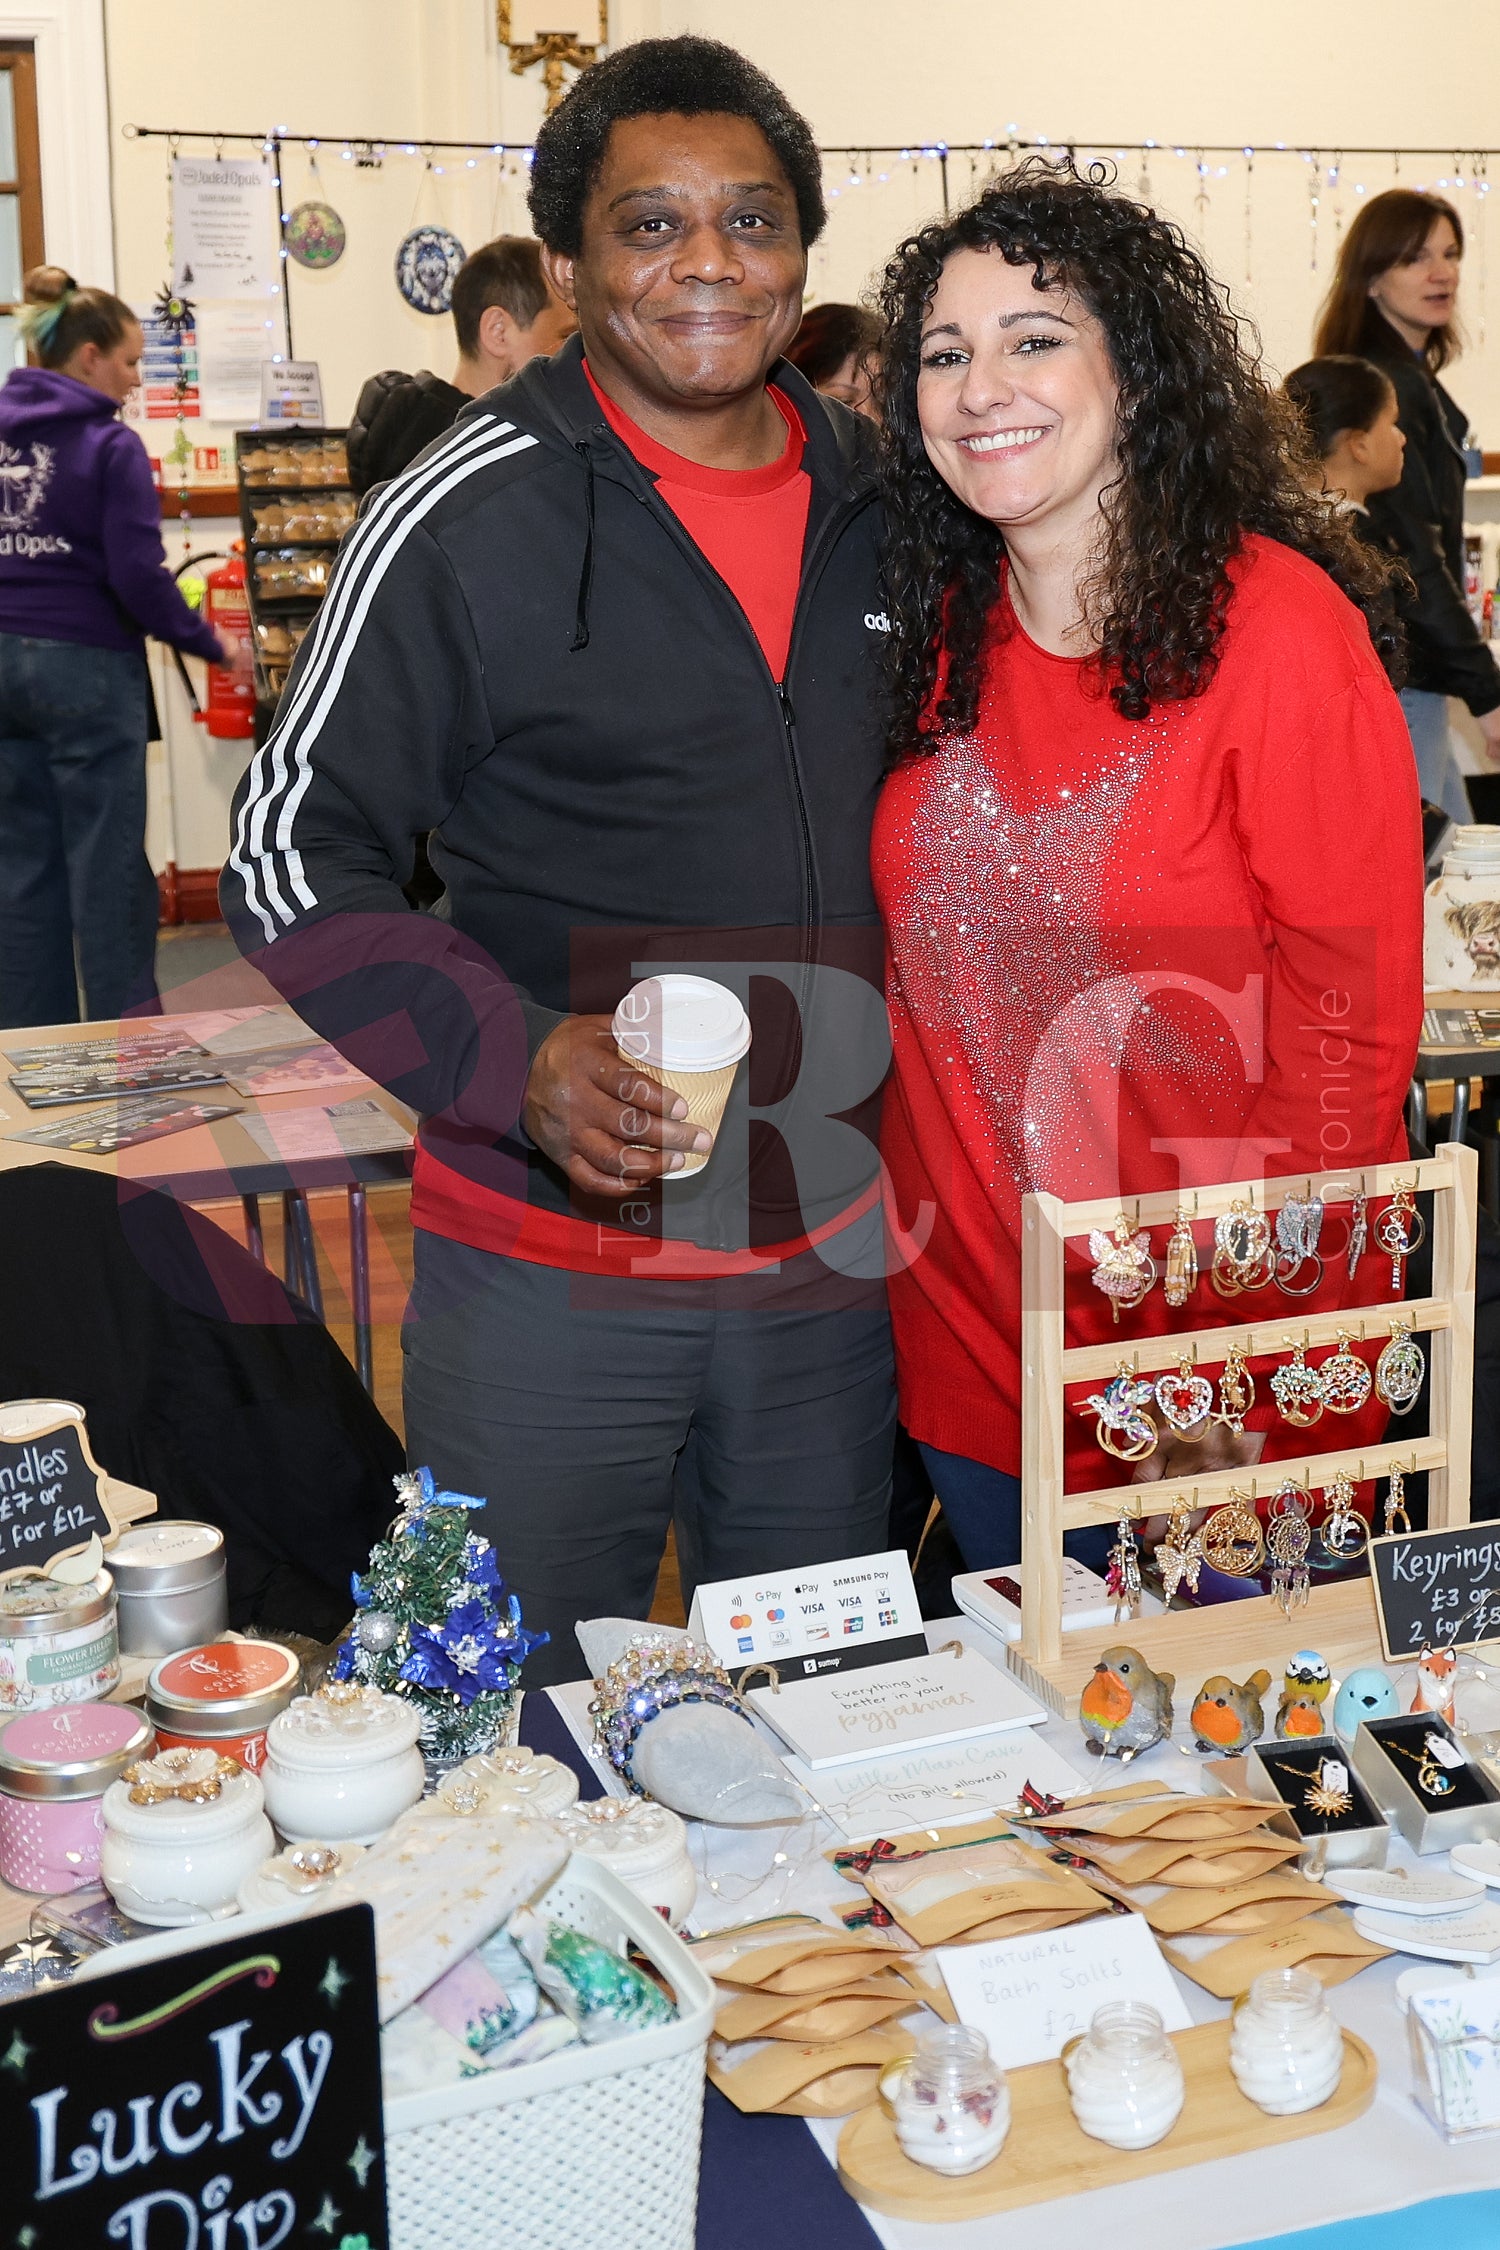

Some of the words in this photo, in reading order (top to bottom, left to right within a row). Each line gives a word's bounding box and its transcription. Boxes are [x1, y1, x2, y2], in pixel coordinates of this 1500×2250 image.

[39, 1482, 63, 1506] or
[12, 1521, 46, 1549] for
[53, 1504, 97, 1537] £12
[833, 1575, 872, 1587] SAMSUNG
[874, 1571, 889, 1582] Pay
[1392, 1542, 1500, 1593] Keyrings
[766, 1590, 782, 1601] Pay
[801, 1583, 819, 1594] Pay
[839, 1595, 863, 1608] VISA
[1431, 1588, 1460, 1612] £3
[1469, 1588, 1492, 1604] or
[800, 1603, 825, 1615] VISA
[1409, 1620, 1426, 1643] 2
[1436, 1617, 1463, 1638] for
[43, 1649, 88, 1669] FLOWER
[831, 1681, 910, 1700] Everything
[916, 1675, 929, 1685] is
[841, 1695, 887, 1710] better
[894, 1691, 907, 1700] in
[915, 1684, 945, 1698] your
[838, 1691, 976, 1733] pyjamas
[834, 1764, 899, 1796] Little
[902, 1750, 963, 1780] Man
[888, 1789, 919, 1804] (No
[921, 1783, 950, 1800] girls
[954, 1771, 1008, 1791] allowed)
[978, 1940, 1076, 1970] NATURAL
[981, 1976, 1041, 2005] Bath
[1060, 1958, 1123, 1990] Salts
[30, 2018, 334, 2201] Lucky
[108, 2174, 296, 2250] Dip
